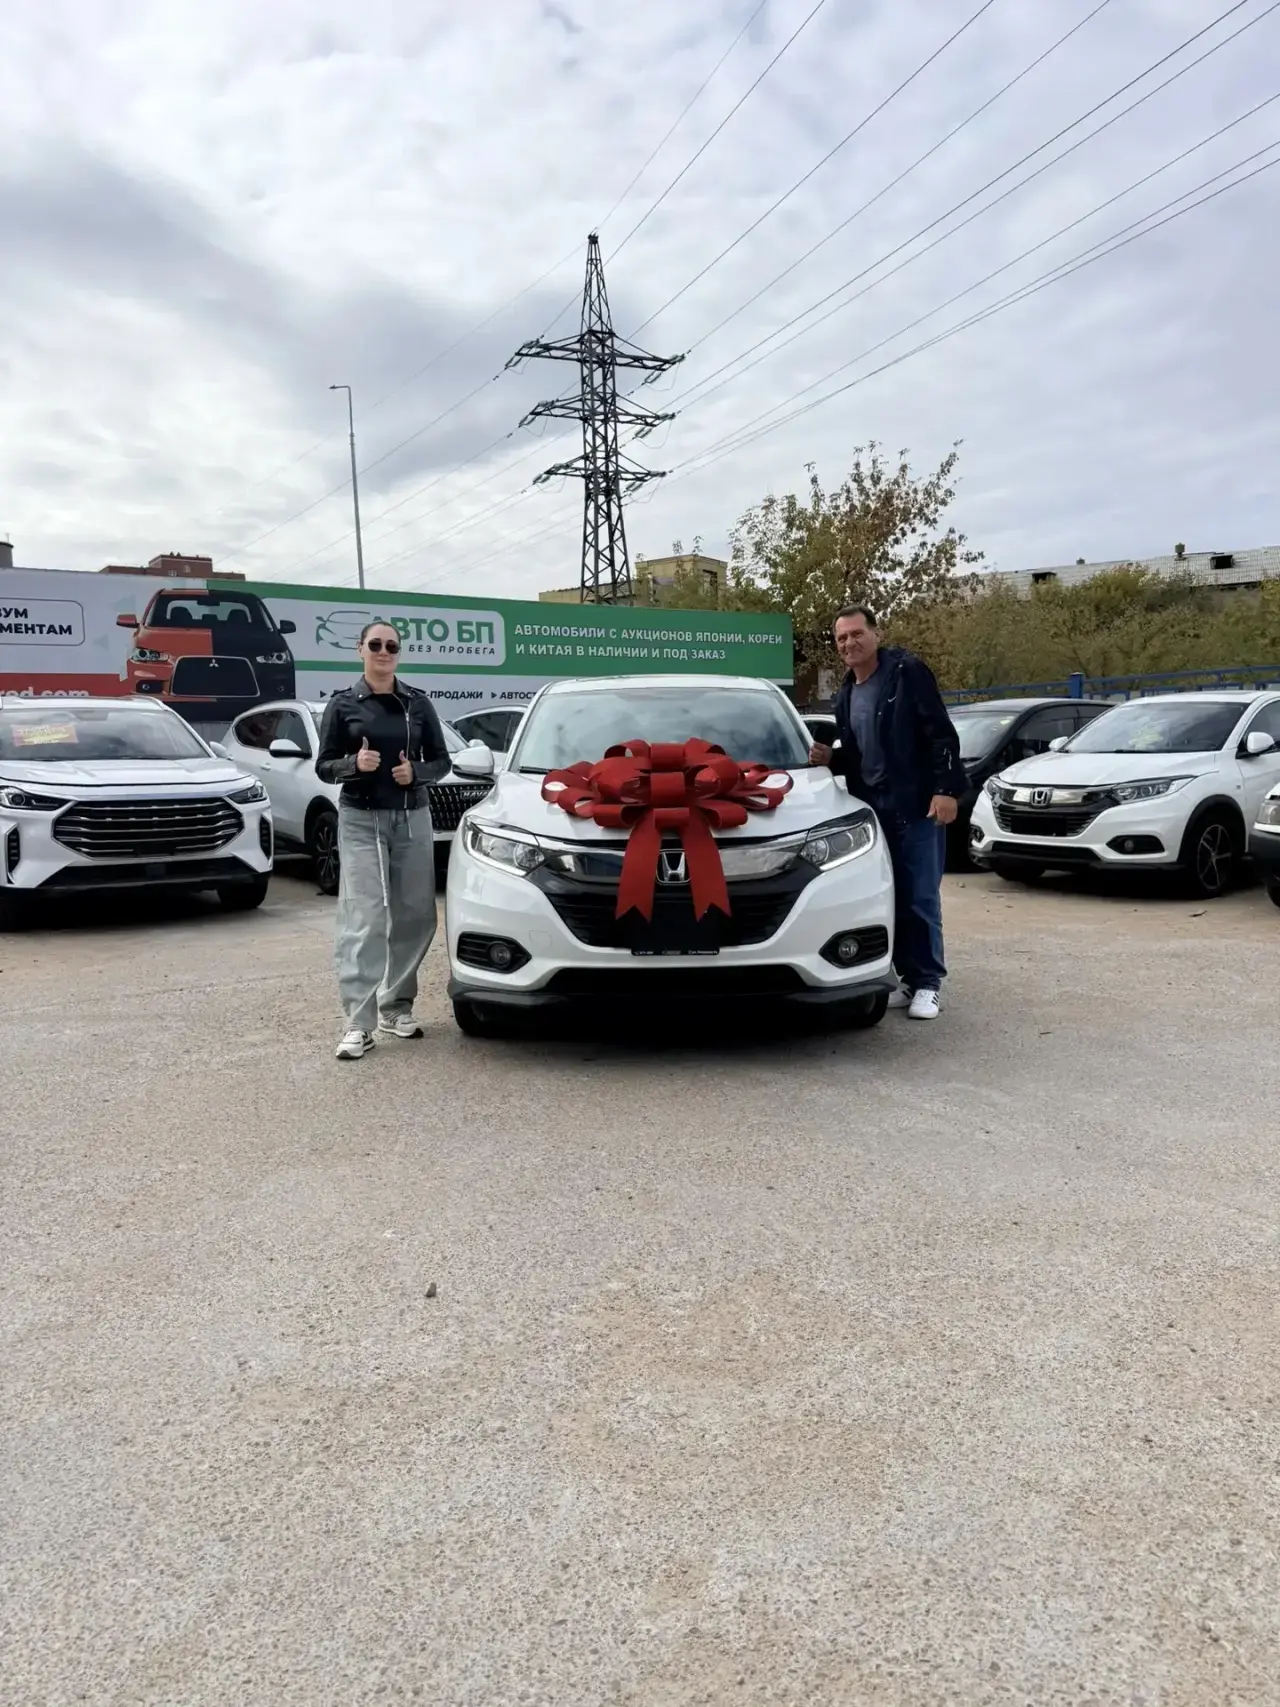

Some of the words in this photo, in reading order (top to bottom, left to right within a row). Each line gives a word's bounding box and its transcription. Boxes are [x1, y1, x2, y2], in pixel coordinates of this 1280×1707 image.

[0, 607, 28, 618] УМ
[373, 616, 449, 642] ВТО
[457, 620, 494, 644] БП
[514, 624, 605, 638] АВТОМОБИЛИ
[609, 628, 617, 638] С
[621, 628, 693, 642] АУКЦИОНОВ
[696, 631, 746, 644] ЯПОНИИ,
[748, 633, 782, 645] КОРЕИ
[408, 644, 432, 653] БЕЗ
[439, 645, 496, 655] ПРОБЕГА
[515, 643, 525, 655] И
[529, 643, 572, 656] КИТАЯ
[576, 645, 585, 656] В
[588, 646, 648, 658] НАЛИЧИИ
[651, 648, 660, 659] И
[663, 648, 688, 661] ПОД
[691, 649, 726, 660] ЗАКАЗ
